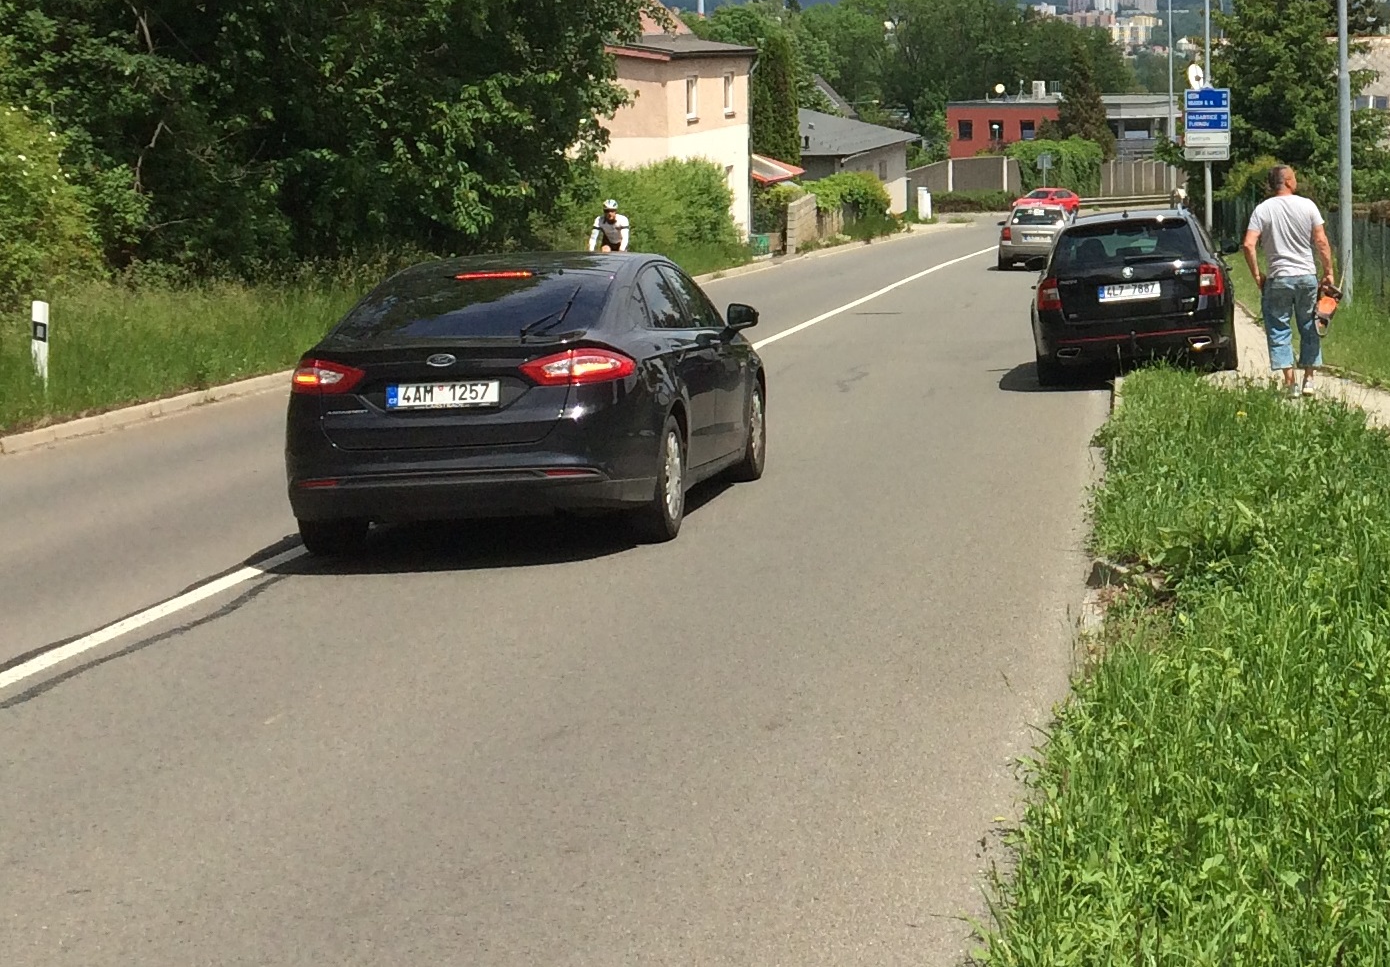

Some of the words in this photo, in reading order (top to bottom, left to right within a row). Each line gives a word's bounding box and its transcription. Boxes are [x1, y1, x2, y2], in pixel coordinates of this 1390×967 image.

[1107, 285, 1124, 296] 4L7
[402, 386, 434, 403] 4AM
[449, 383, 490, 401] 1257
